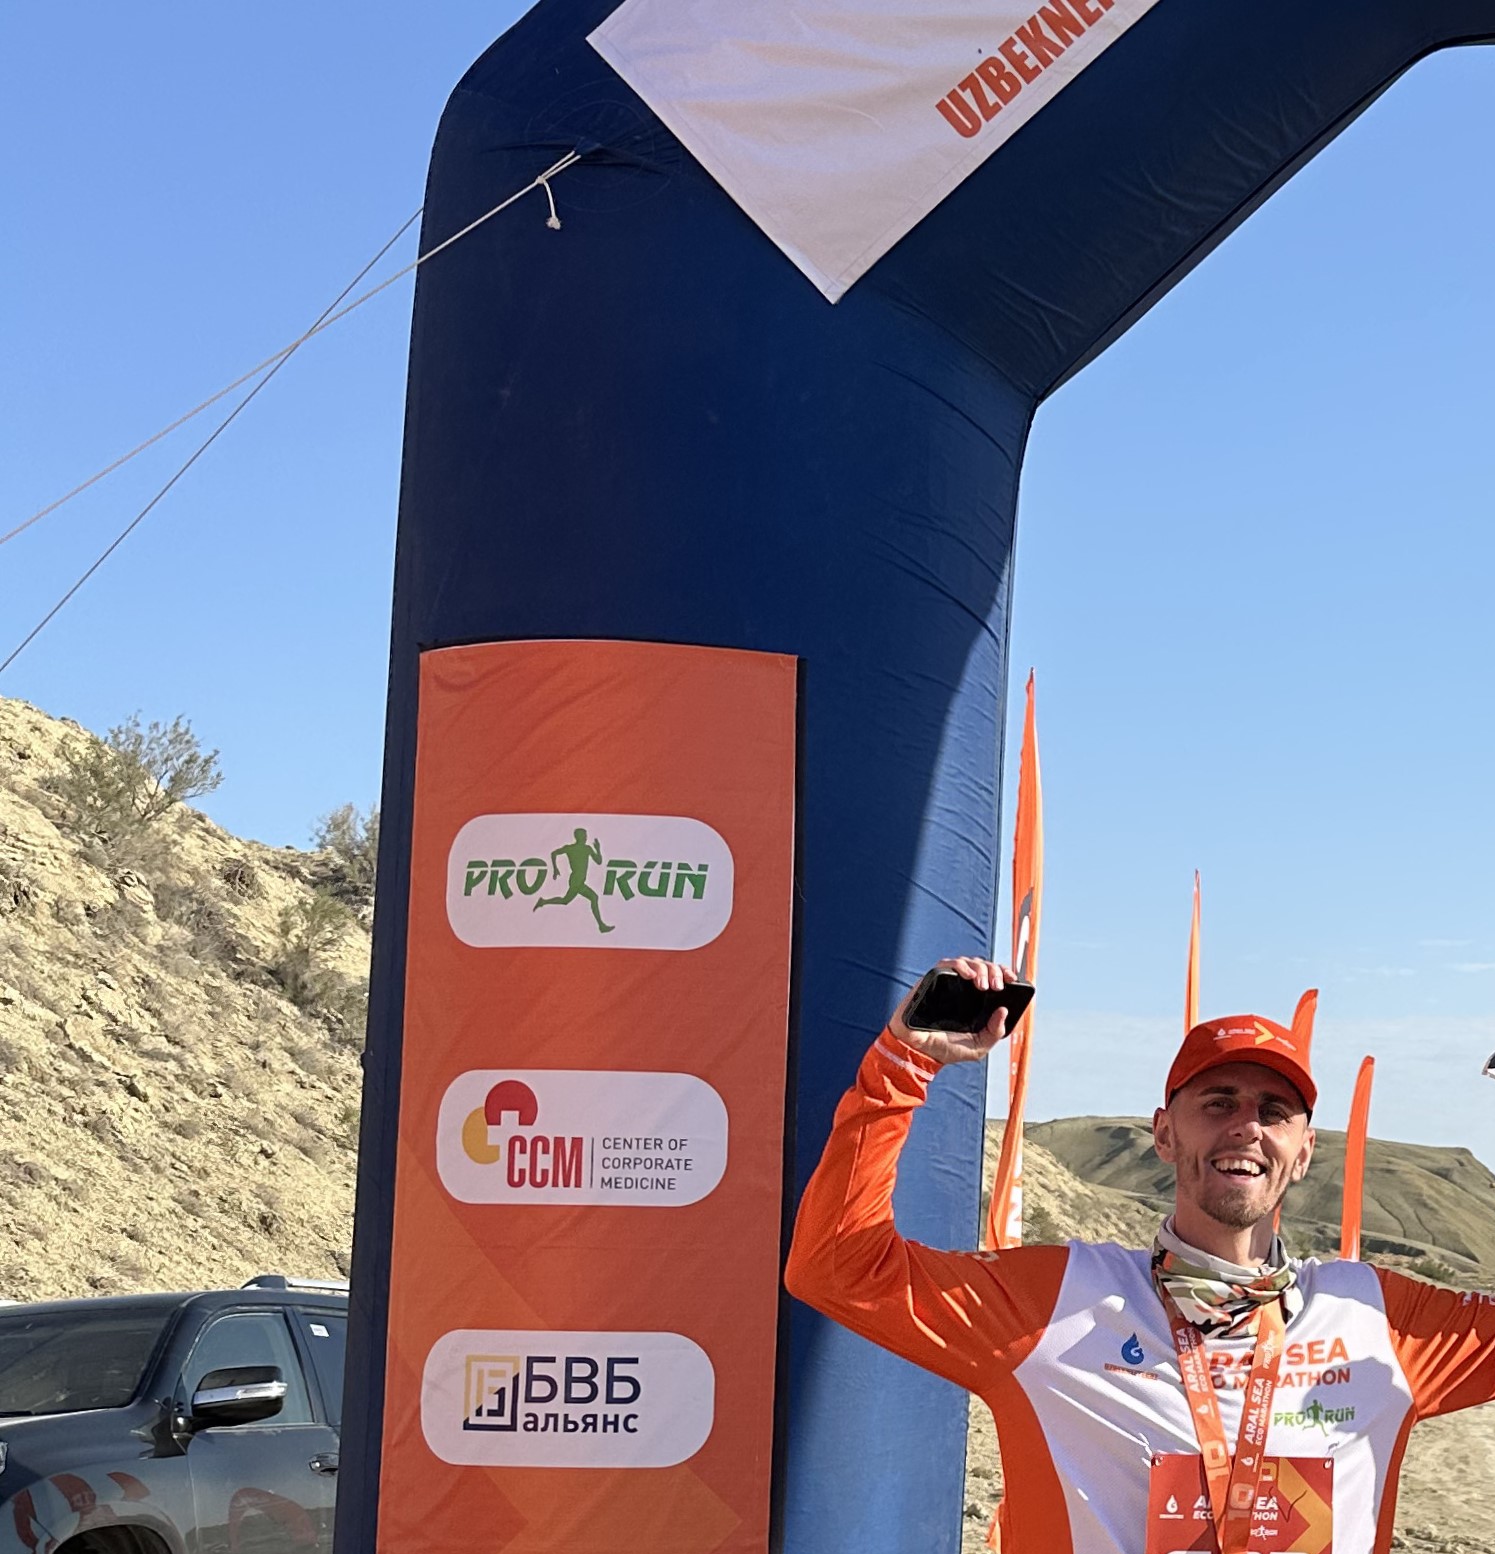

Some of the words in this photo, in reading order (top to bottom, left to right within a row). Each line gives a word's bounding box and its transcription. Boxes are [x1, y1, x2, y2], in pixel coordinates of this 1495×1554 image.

[935, 0, 1115, 138] UZBEKNE
[463, 858, 548, 899] PRO
[603, 859, 709, 901] RUN
[602, 1137, 663, 1150] CENTER
[668, 1138, 688, 1151] OF
[506, 1135, 583, 1188] CCM
[601, 1157, 693, 1171] CORPORATE
[600, 1177, 676, 1190] MEDICINE
[1177, 1328, 1191, 1354] SEA
[1286, 1337, 1349, 1366] SEA
[524, 1356, 641, 1405] БВБ
[1183, 1356, 1201, 1393] ARAL
[1251, 1378, 1265, 1405] SEA
[523, 1411, 639, 1433] альянс
[1244, 1407, 1259, 1444] ARAL
[1255, 1427, 1264, 1445] ECO
[1260, 1380, 1273, 1427] MARATHON
[1274, 1411, 1305, 1426] PRO
[1324, 1407, 1355, 1424] RUN
[1256, 1496, 1279, 1510] EA
